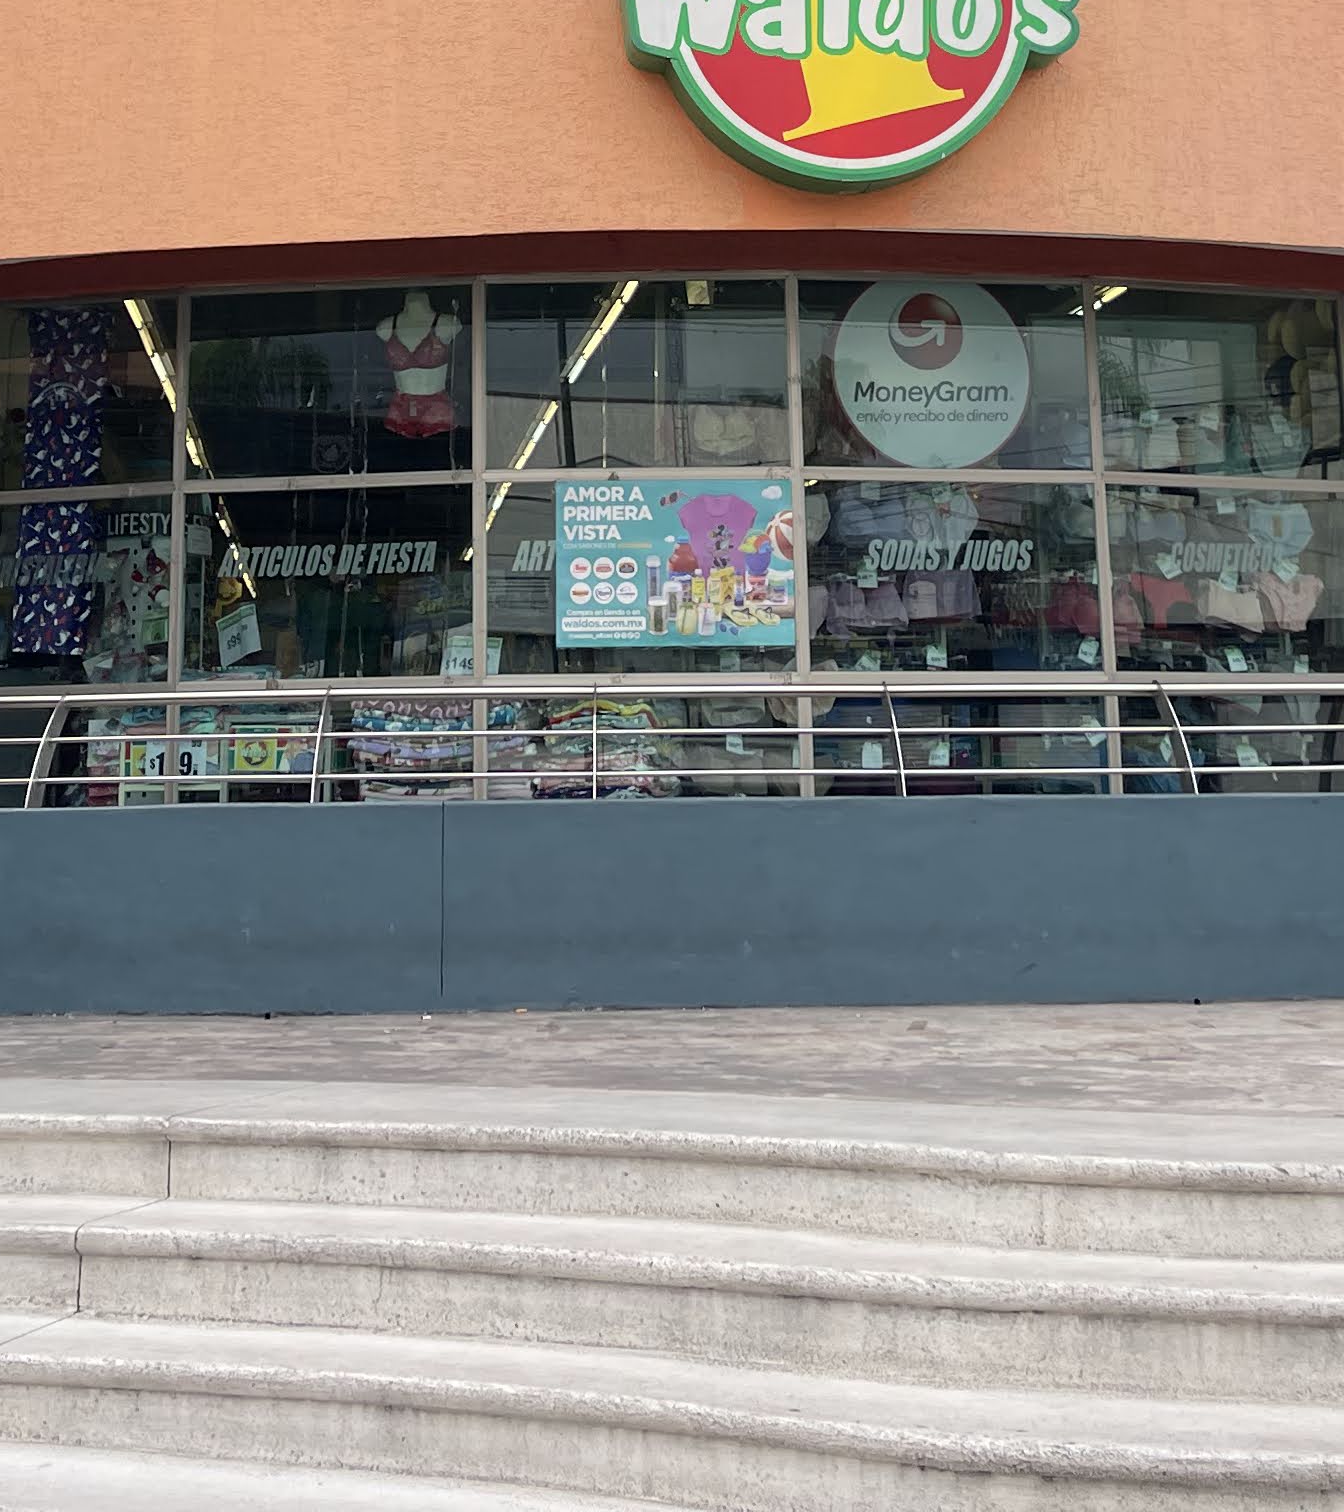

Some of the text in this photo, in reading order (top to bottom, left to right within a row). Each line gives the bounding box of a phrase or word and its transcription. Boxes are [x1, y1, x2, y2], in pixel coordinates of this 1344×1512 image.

[854, 380, 1008, 408] MoneyGram
[894, 412, 902, 424] y
[903, 409, 946, 422] recibo
[947, 409, 965, 422] de
[966, 408, 1009, 422] dinero
[563, 486, 645, 502] AMOR A
[563, 505, 654, 521] PRIMERA
[106, 511, 190, 535] LIFESTY
[563, 525, 622, 541] VISTA
[217, 541, 437, 577] ARTICULOS DE FIESTA
[865, 539, 1034, 572] SODAS Y JUGOS
[563, 619, 643, 628] waldos.com.mx
